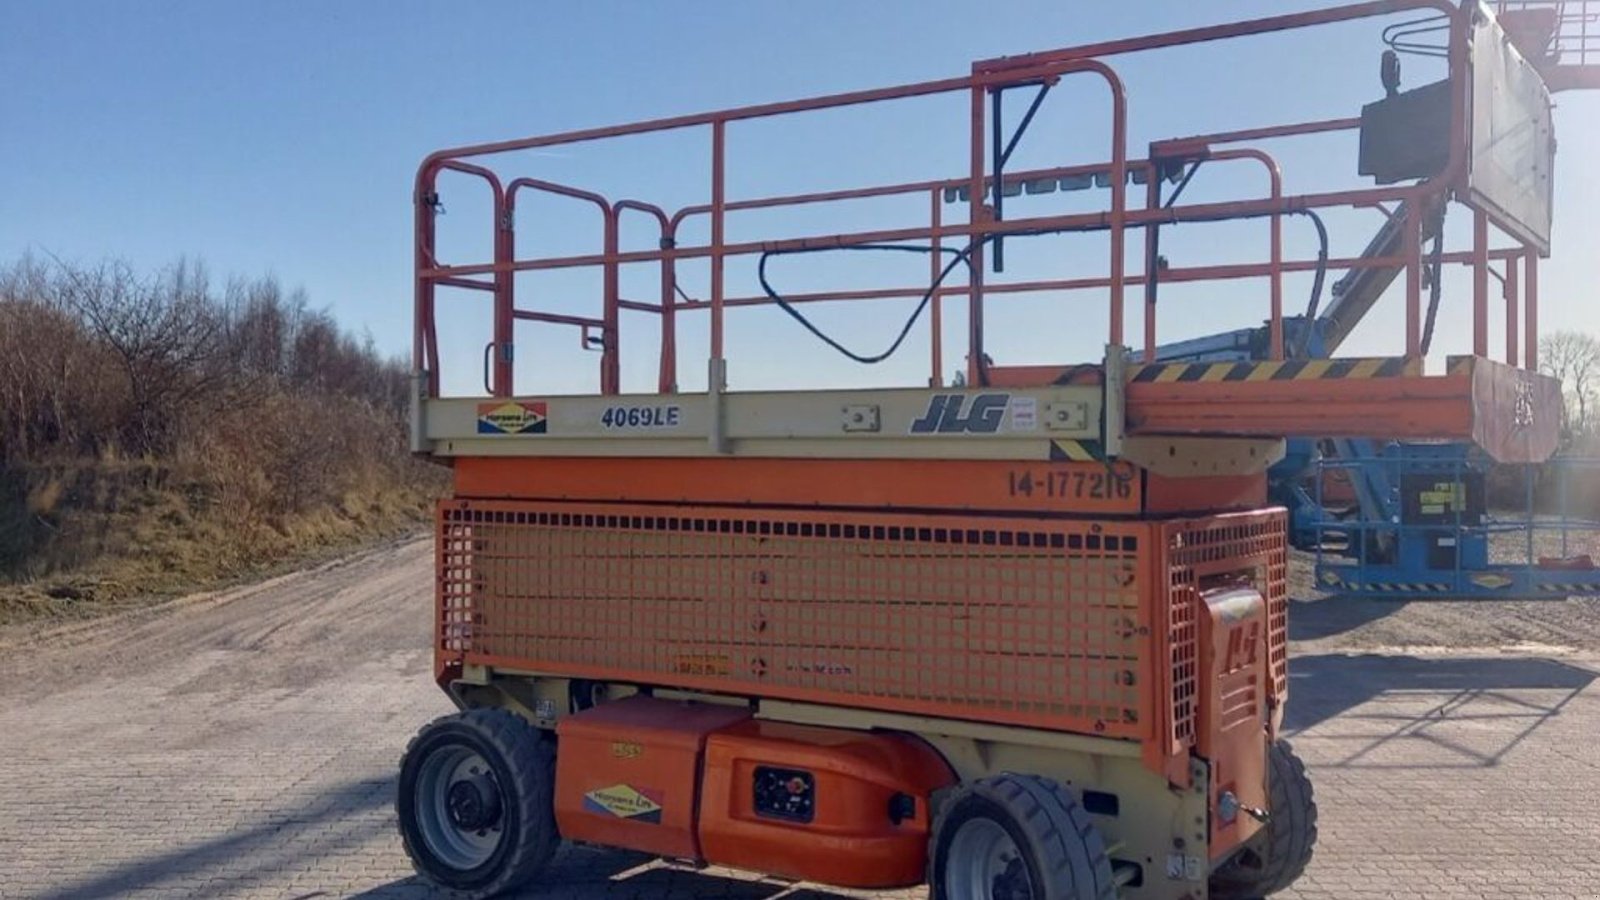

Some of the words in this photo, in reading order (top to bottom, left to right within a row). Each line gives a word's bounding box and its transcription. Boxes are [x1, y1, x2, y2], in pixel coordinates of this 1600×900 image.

[601, 406, 680, 428] 4069LE
[909, 393, 1011, 433] JLG
[1008, 470, 1132, 499] 14-177216
